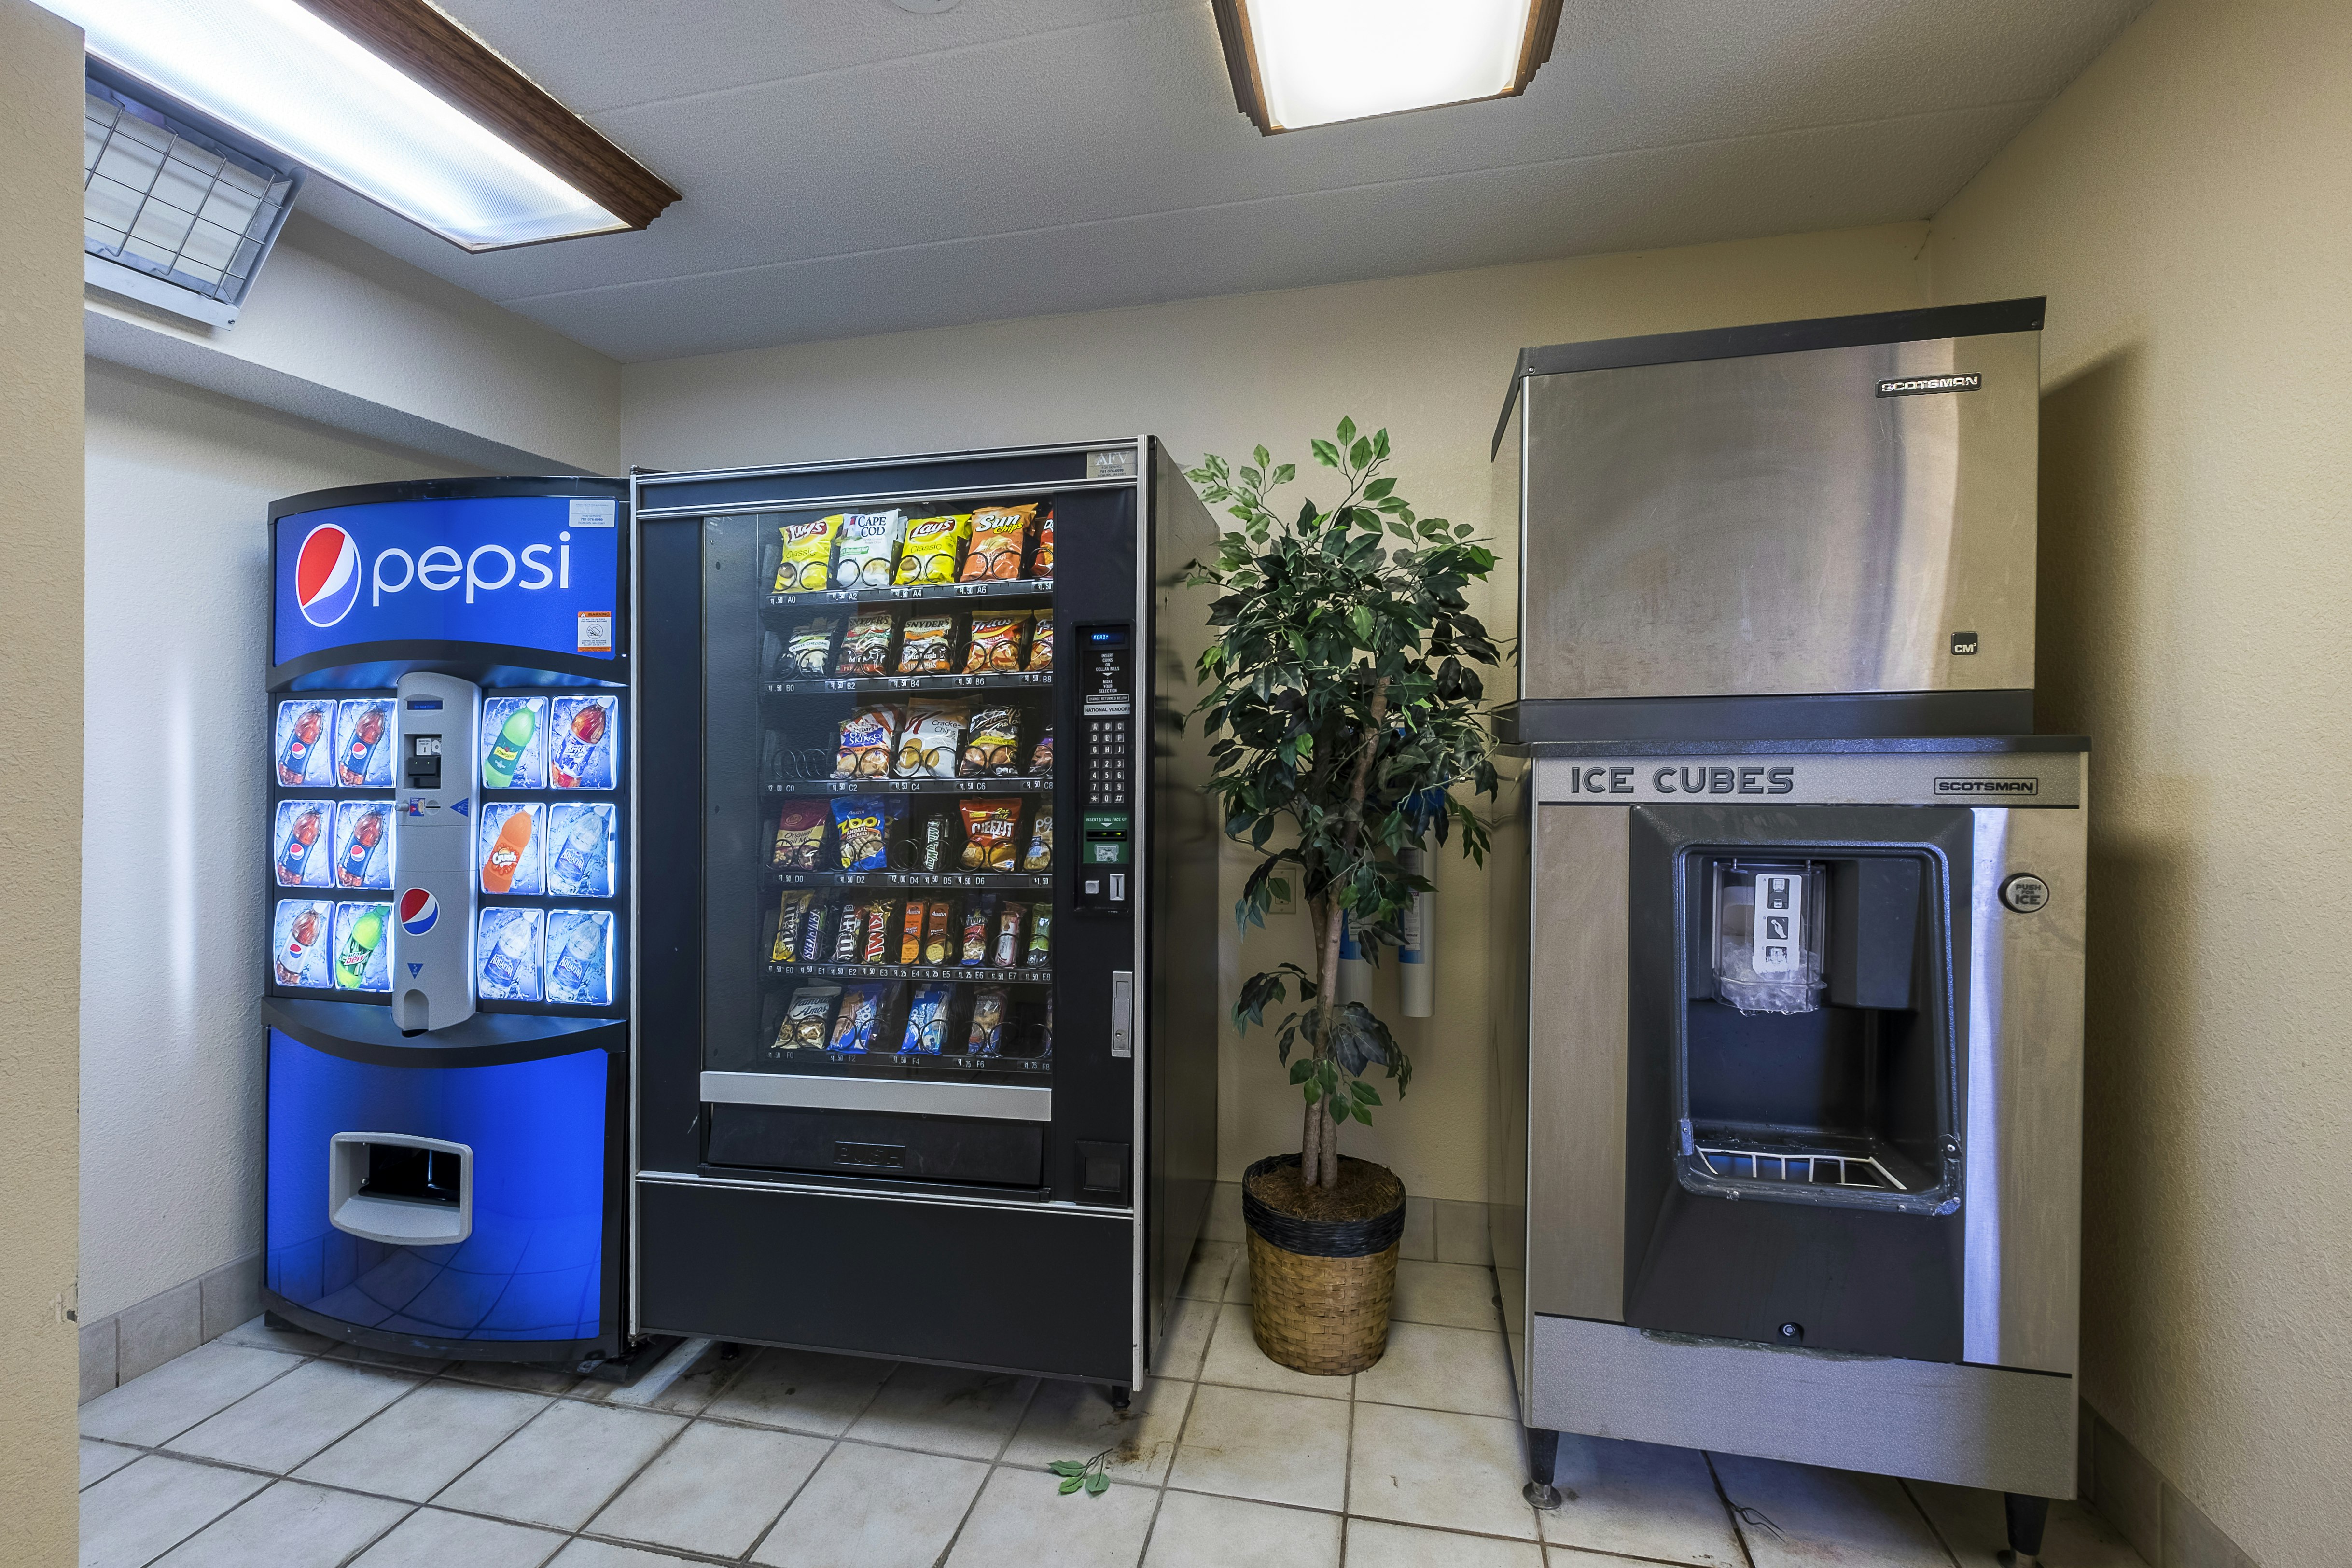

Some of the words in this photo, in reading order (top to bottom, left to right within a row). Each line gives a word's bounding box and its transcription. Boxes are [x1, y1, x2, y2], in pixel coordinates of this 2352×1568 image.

[1881, 376, 1978, 392] SCOTSMAN
[1095, 451, 1130, 466] AFV
[858, 516, 886, 527] CAPE
[976, 515, 1020, 532] Sun
[861, 526, 885, 537] COD
[994, 522, 1023, 534] Chips
[786, 548, 816, 558] Classic
[911, 543, 942, 553] Classic
[373, 531, 571, 607] pepsi
[973, 618, 1012, 633] Fritos
[850, 736, 876, 745] SKINS
[1572, 767, 1634, 793] ICE
[1652, 767, 1794, 794] CUBES
[1939, 782, 2033, 791] SCOTSMAN
[837, 817, 877, 833] ZOO
[847, 827, 867, 835] ANIMAL
[784, 829, 813, 838] Original
[847, 832, 867, 840] CRACKERS
[492, 851, 517, 865] Crush
[2016, 895, 2040, 905] ICE
[803, 911, 820, 960] SNICKERS
[864, 912, 884, 961] TWIX
[793, 1005, 828, 1017] Amos
